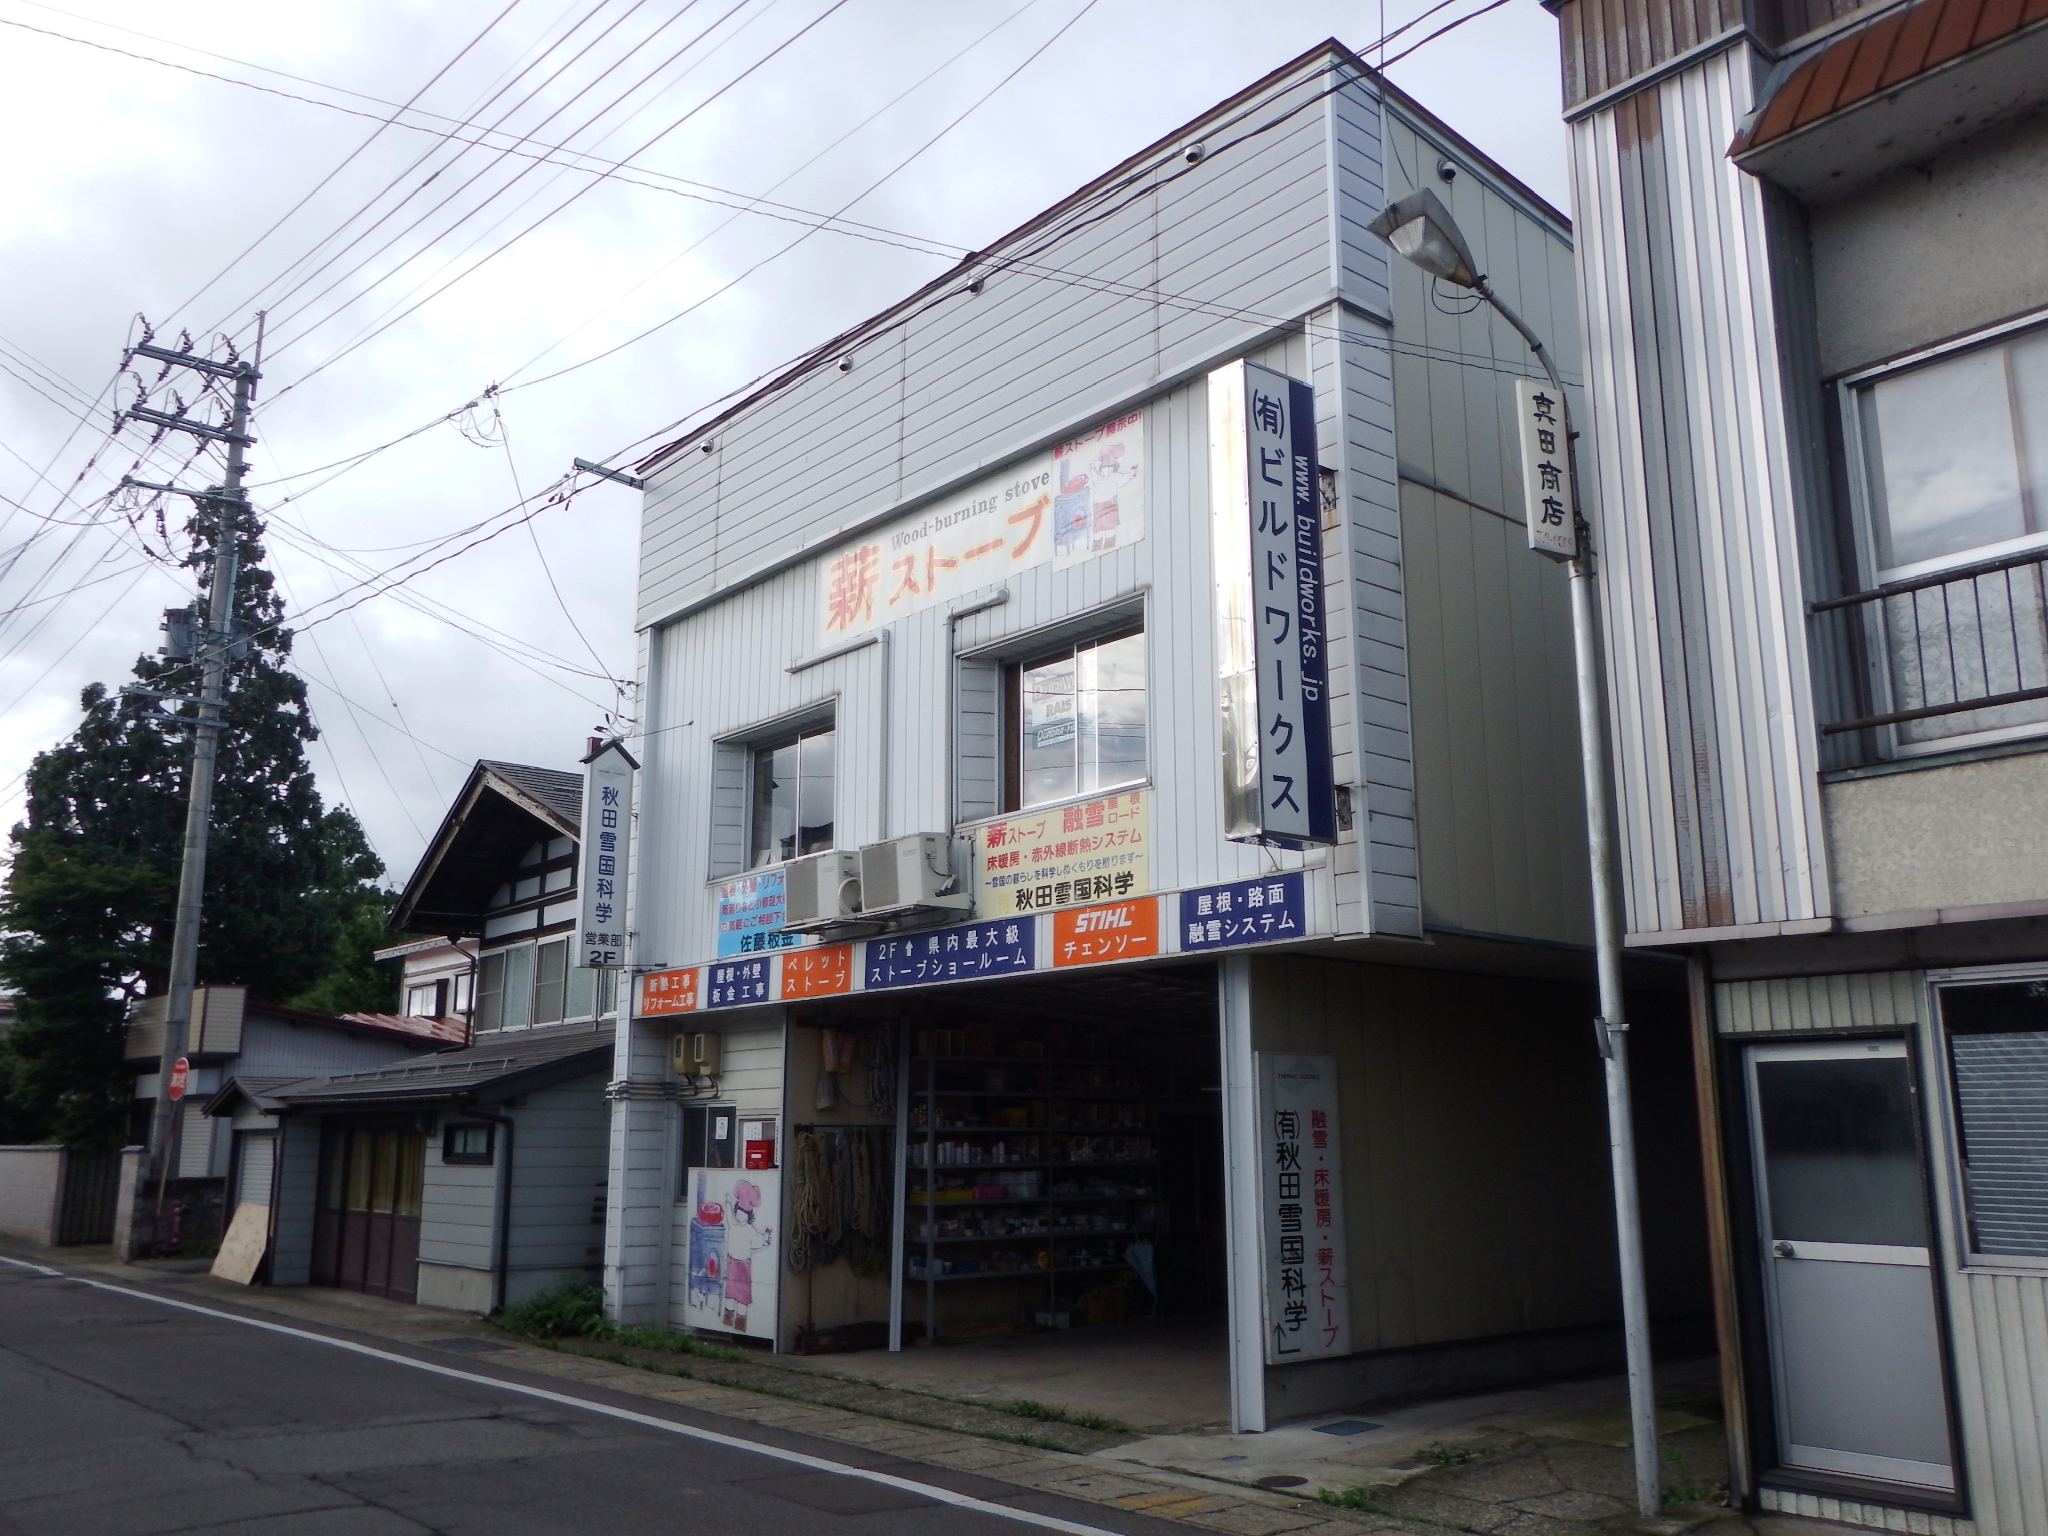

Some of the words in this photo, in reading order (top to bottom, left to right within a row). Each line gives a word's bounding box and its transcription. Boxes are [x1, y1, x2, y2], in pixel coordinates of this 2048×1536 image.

[1532, 391, 1566, 527] 真田商店
[891, 495, 998, 551] Wood-burning
[1004, 471, 1050, 503] stove
[826, 493, 1050, 632] 薪ストーブ
[1046, 698, 1072, 718] RAIS
[986, 821, 1047, 849] 薪ストーブ
[1063, 801, 1105, 834] 融雪
[1108, 806, 1141, 824] ロード
[595, 786, 619, 924] 秋田雪国科学
[986, 828, 1143, 872] 床暖房・赤外線断熱システム
[722, 894, 785, 915] 雨漏りなど小修理大
[1015, 871, 1134, 911] 秋田雪国科学
[1196, 883, 1285, 916] 屋根・路面
[1074, 906, 1133, 934] STIHL
[1188, 910, 1295, 945] 融雪システム
[585, 931, 623, 948] 営業部
[878, 942, 898, 961] 2F
[928, 924, 1021, 955] 県内最大級
[1063, 933, 1147, 960] チェンソー
[589, 951, 617, 964] 2F
[787, 950, 846, 972] ペレット
[871, 947, 1028, 983] ストーブショールーム
[650, 973, 691, 993] 断熱工事
[716, 962, 762, 984] 屋根・外壁
[786, 971, 846, 994] ストーブ
[643, 991, 695, 1012] リフォーム工事
[711, 982, 765, 1004] 板金工事
